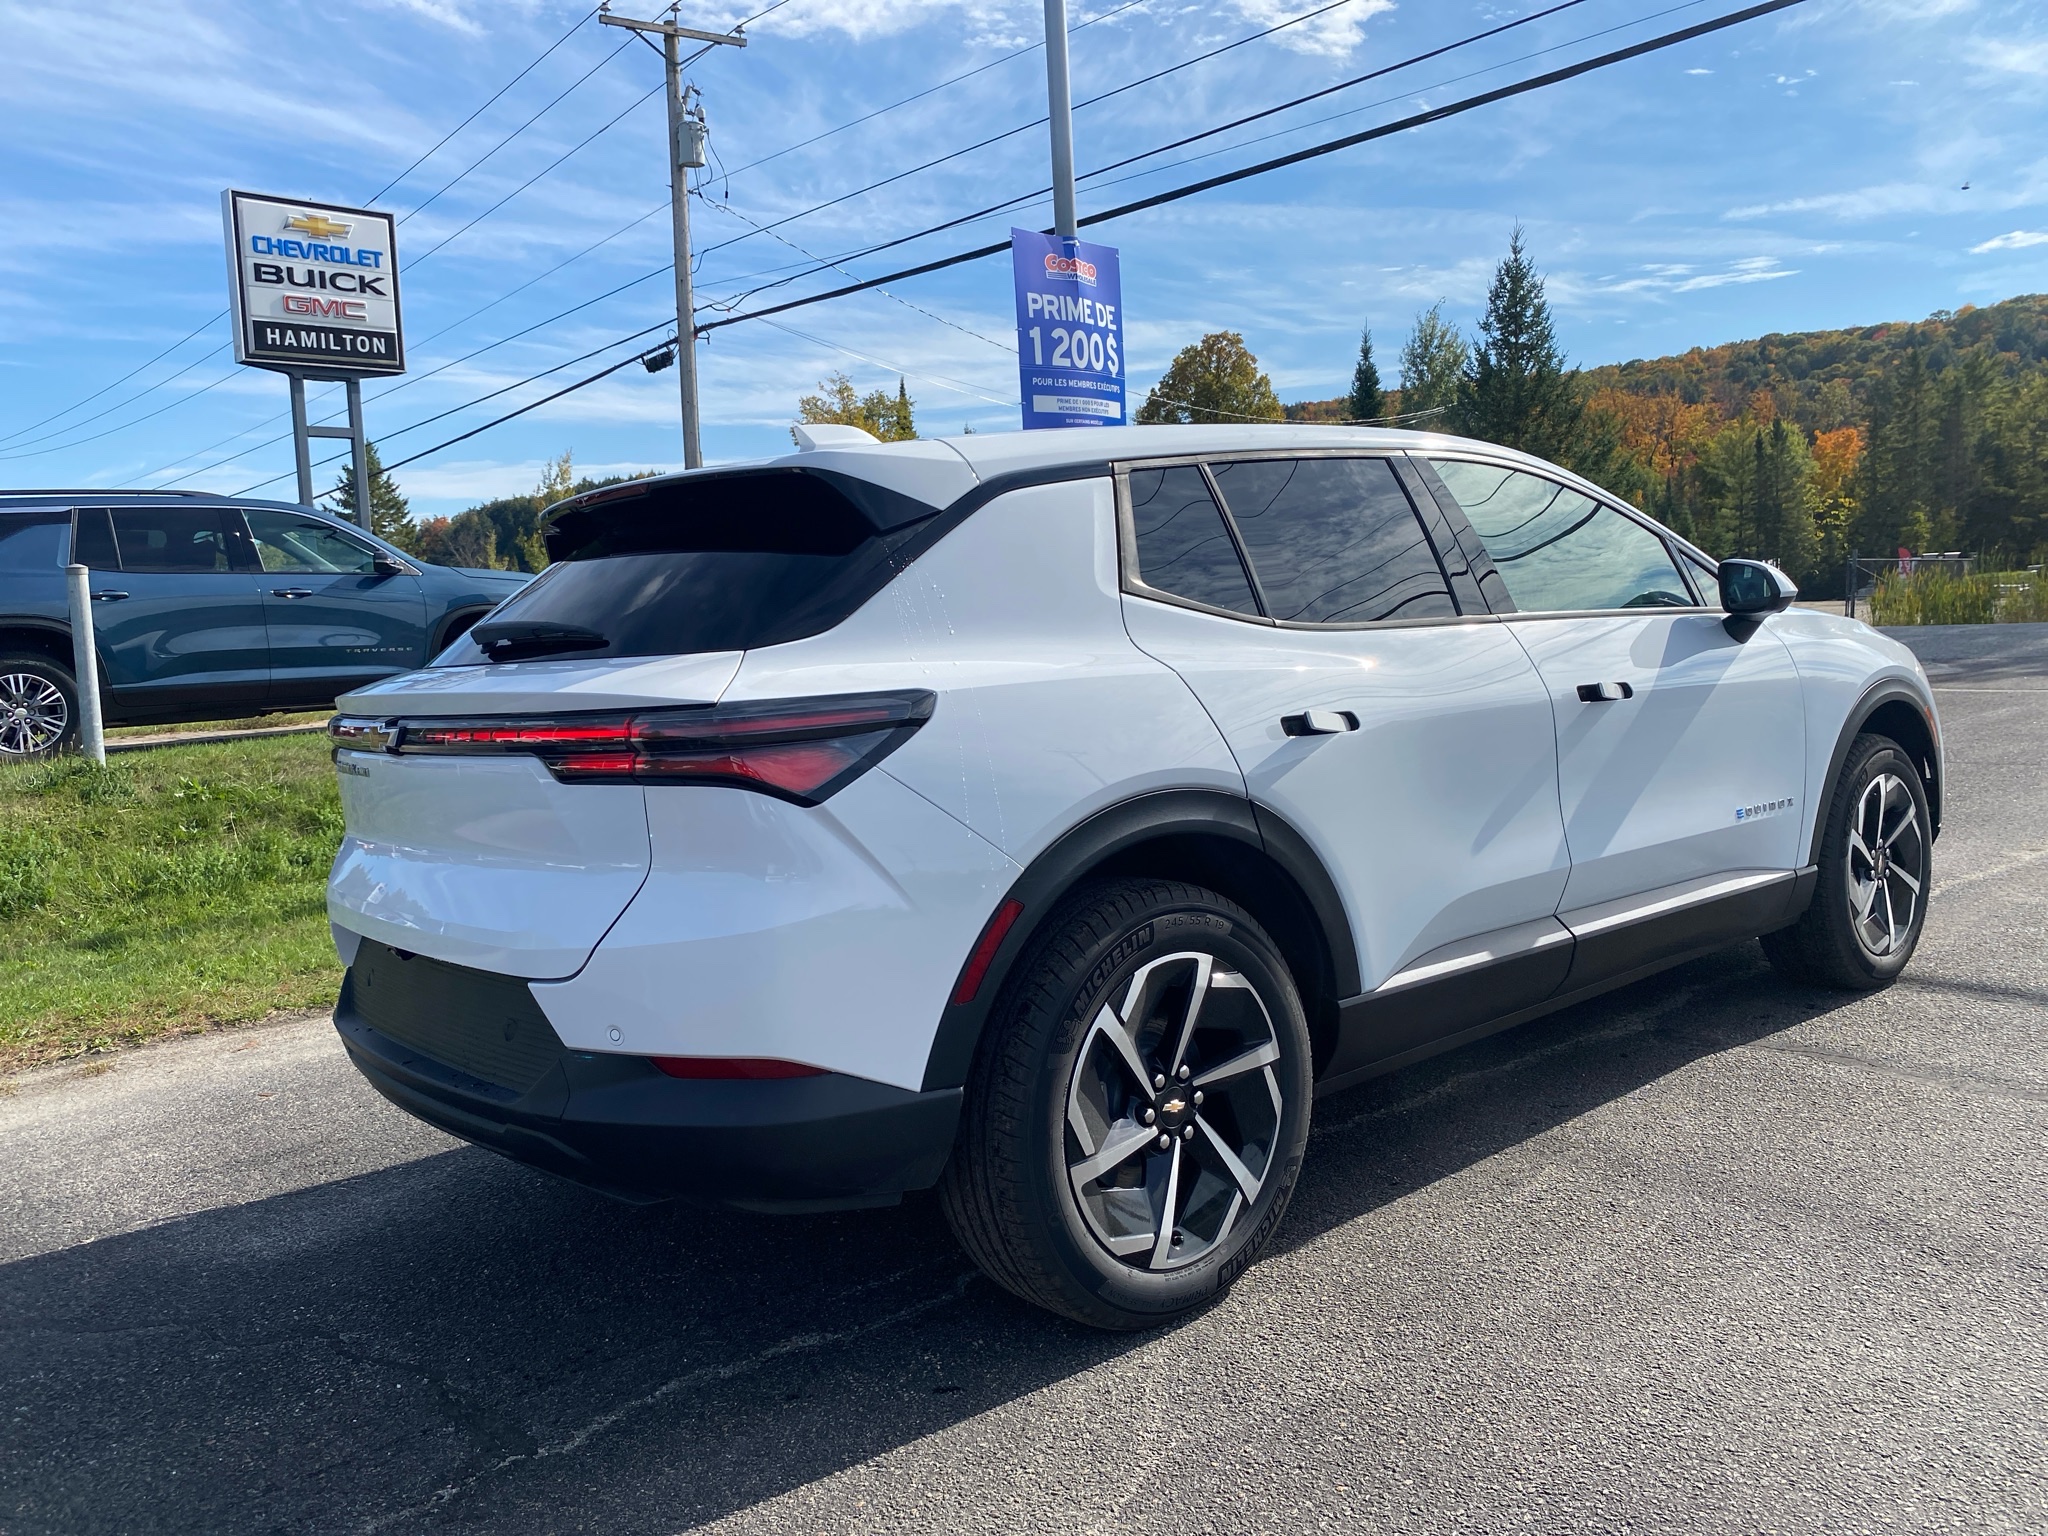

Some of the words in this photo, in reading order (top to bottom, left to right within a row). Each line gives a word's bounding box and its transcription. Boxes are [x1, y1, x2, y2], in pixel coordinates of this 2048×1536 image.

[251, 235, 383, 268] CHEVROLET
[1044, 253, 1096, 278] COSTCO
[253, 262, 387, 296] BUICK
[283, 294, 368, 321] GMC
[1026, 292, 1094, 325] PRIME
[1095, 301, 1117, 331] DE
[266, 328, 386, 354] HAMILTON
[1032, 377, 1053, 386] POUR
[1054, 378, 1067, 387] LES
[1068, 379, 1096, 390] MEMBRES
[1736, 797, 1794, 819] EQUINOX
[1073, 926, 1151, 1017] MICHELIN
[1220, 1191, 1285, 1284] MICHELIN
